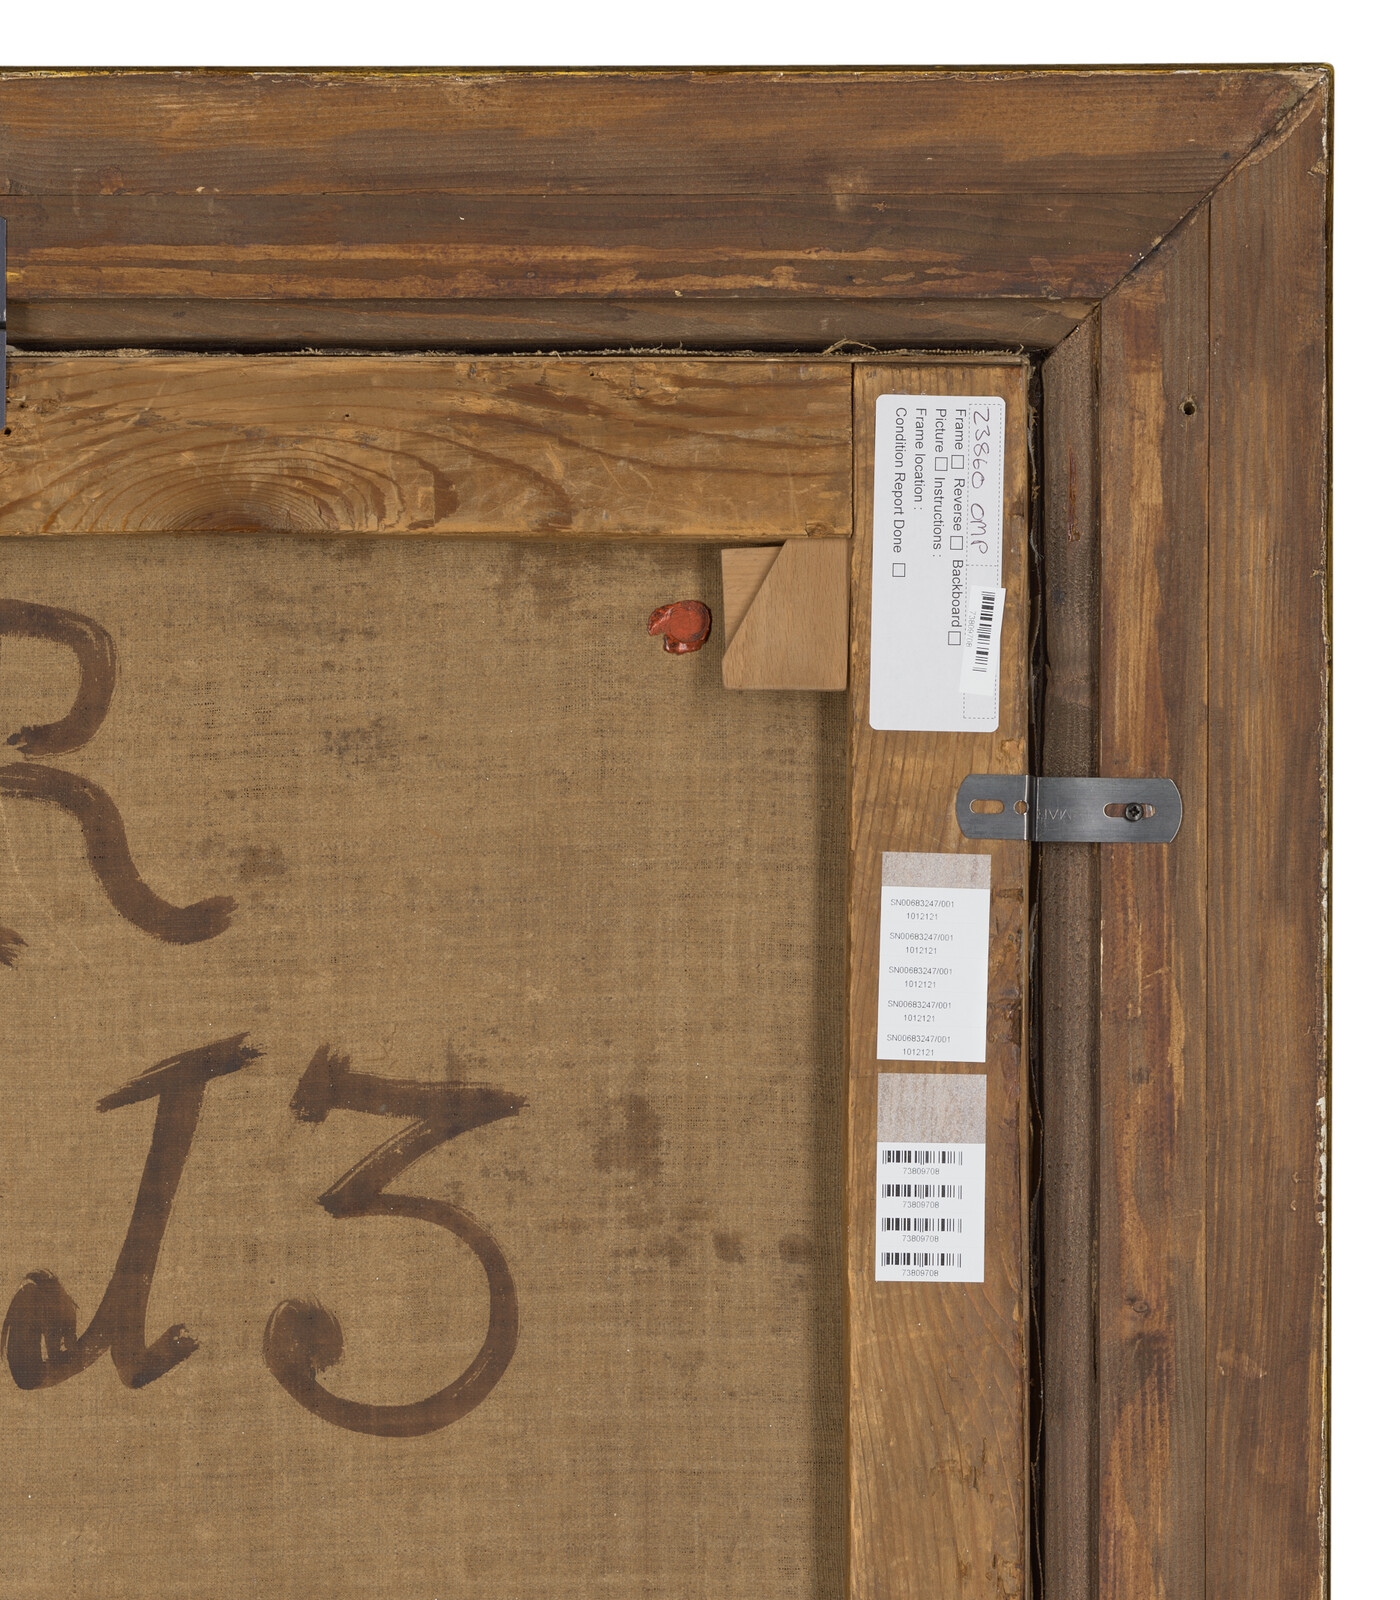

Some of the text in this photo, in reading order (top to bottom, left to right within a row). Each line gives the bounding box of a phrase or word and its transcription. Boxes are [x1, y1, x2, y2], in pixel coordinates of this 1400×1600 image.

[914, 407, 928, 450] Frame
[934, 408, 948, 453] Picture
[890, 407, 908, 554] Condition Report Done
[913, 453, 927, 503] location
[969, 406, 991, 555] 23860 OMP
[932, 477, 946, 551] Instructions
[950, 408, 967, 628] Frame Reverse Backboard
[890, 898, 955, 908] SN00683247/001
[906, 912, 938, 921] 1012121
[889, 931, 954, 942] SN00683247/001
[905, 946, 937, 955] 1012121
[888, 965, 953, 976] SN00683247/001
[904, 979, 936, 989] 1012121
[887, 999, 952, 1010] SN00683247/001
[903, 1013, 935, 1023] 1012121
[886, 1033, 951, 1044] SN00683247/001
[903, 1047, 934, 1057] 1012121
[903, 1167, 940, 1176] 73809708
[902, 1200, 940, 1209] 73809708
[901, 1234, 940, 1243] 73809708
[902, 1268, 939, 1277] 73809708
